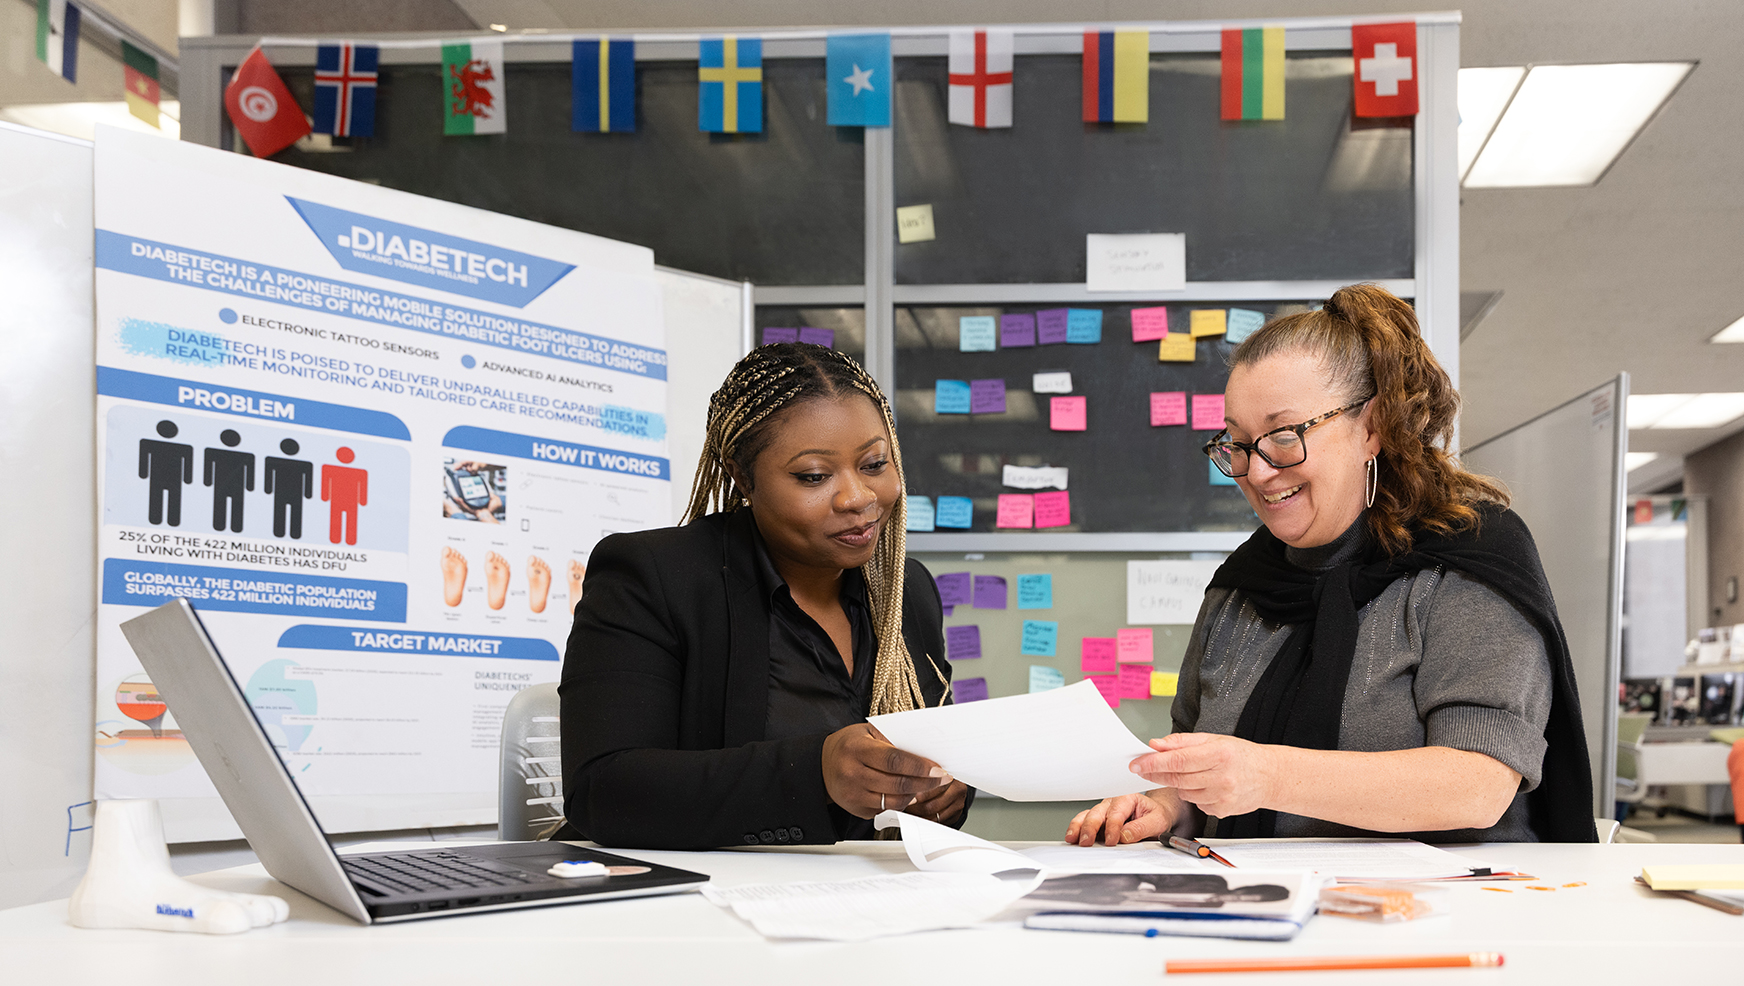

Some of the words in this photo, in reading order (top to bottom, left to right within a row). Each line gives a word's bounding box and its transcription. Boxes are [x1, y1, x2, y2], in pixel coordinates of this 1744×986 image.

[352, 250, 392, 266] WALKING
[395, 259, 434, 275] TOWARDS
[436, 268, 478, 285] WELLNESS
[131, 242, 237, 276] DIABETECH
[241, 266, 258, 280] IS
[260, 270, 276, 284] A
[277, 274, 380, 306] PIONEERING
[383, 292, 442, 318] MOBILE
[445, 308, 518, 334] SOLUTION
[521, 325, 590, 350] DESIGNED
[591, 338, 610, 353] TO
[611, 343, 668, 366] ADDRESS
[166, 264, 204, 284] THE
[206, 272, 322, 308] CHALLENGES
[325, 297, 350, 312] OF
[352, 303, 440, 332] MANAGING
[443, 322, 509, 346] DIABETIC
[512, 337, 550, 354] FOOT
[551, 344, 603, 364] ULCERS
[605, 355, 648, 374] USING:
[242, 314, 328, 340] ELECTRONIC
[331, 332, 380, 349] TATTOO
[382, 342, 440, 360] SENSORS
[166, 343, 258, 370] REAL-TIME
[262, 360, 368, 389] MONITORING
[371, 380, 405, 395] AND
[408, 385, 478, 408] TAILORED
[480, 398, 516, 414] CARE
[168, 329, 268, 358] DIABETECH
[272, 348, 286, 361] IS
[290, 352, 350, 372] POISED
[353, 362, 374, 376] TO
[378, 368, 440, 389] DELIVER
[443, 380, 550, 407] UNPARALLELED
[552, 398, 634, 423] CAPABILITIES
[636, 414, 649, 426] IN
[482, 361, 544, 380] ADVANCED
[559, 374, 614, 394] ANALYTICS
[178, 386, 296, 420] PROBLEM
[532, 442, 578, 462] HOW
[580, 449, 597, 466] IT
[598, 452, 662, 477] WORKS
[119, 530, 147, 544] 25%
[150, 533, 172, 545] OF
[173, 534, 200, 548] THE
[204, 538, 227, 550] 422
[230, 541, 286, 556] MILLION
[288, 547, 368, 564] INDIVIDUALS
[136, 544, 184, 558] LIVING
[187, 548, 224, 562] WITH
[226, 552, 290, 567] DIABETES
[293, 558, 320, 570] HAS
[322, 560, 347, 572] DFU
[125, 583, 210, 600] SURPASSES
[211, 589, 236, 602] 422
[238, 592, 294, 606] MILLION
[296, 596, 375, 612] INDIVIDUALS
[202, 577, 231, 590] THE
[233, 580, 294, 596] DIABETIC
[296, 585, 377, 601] POPULATION
[352, 632, 426, 650] TARGET
[428, 636, 502, 654] MARKET
